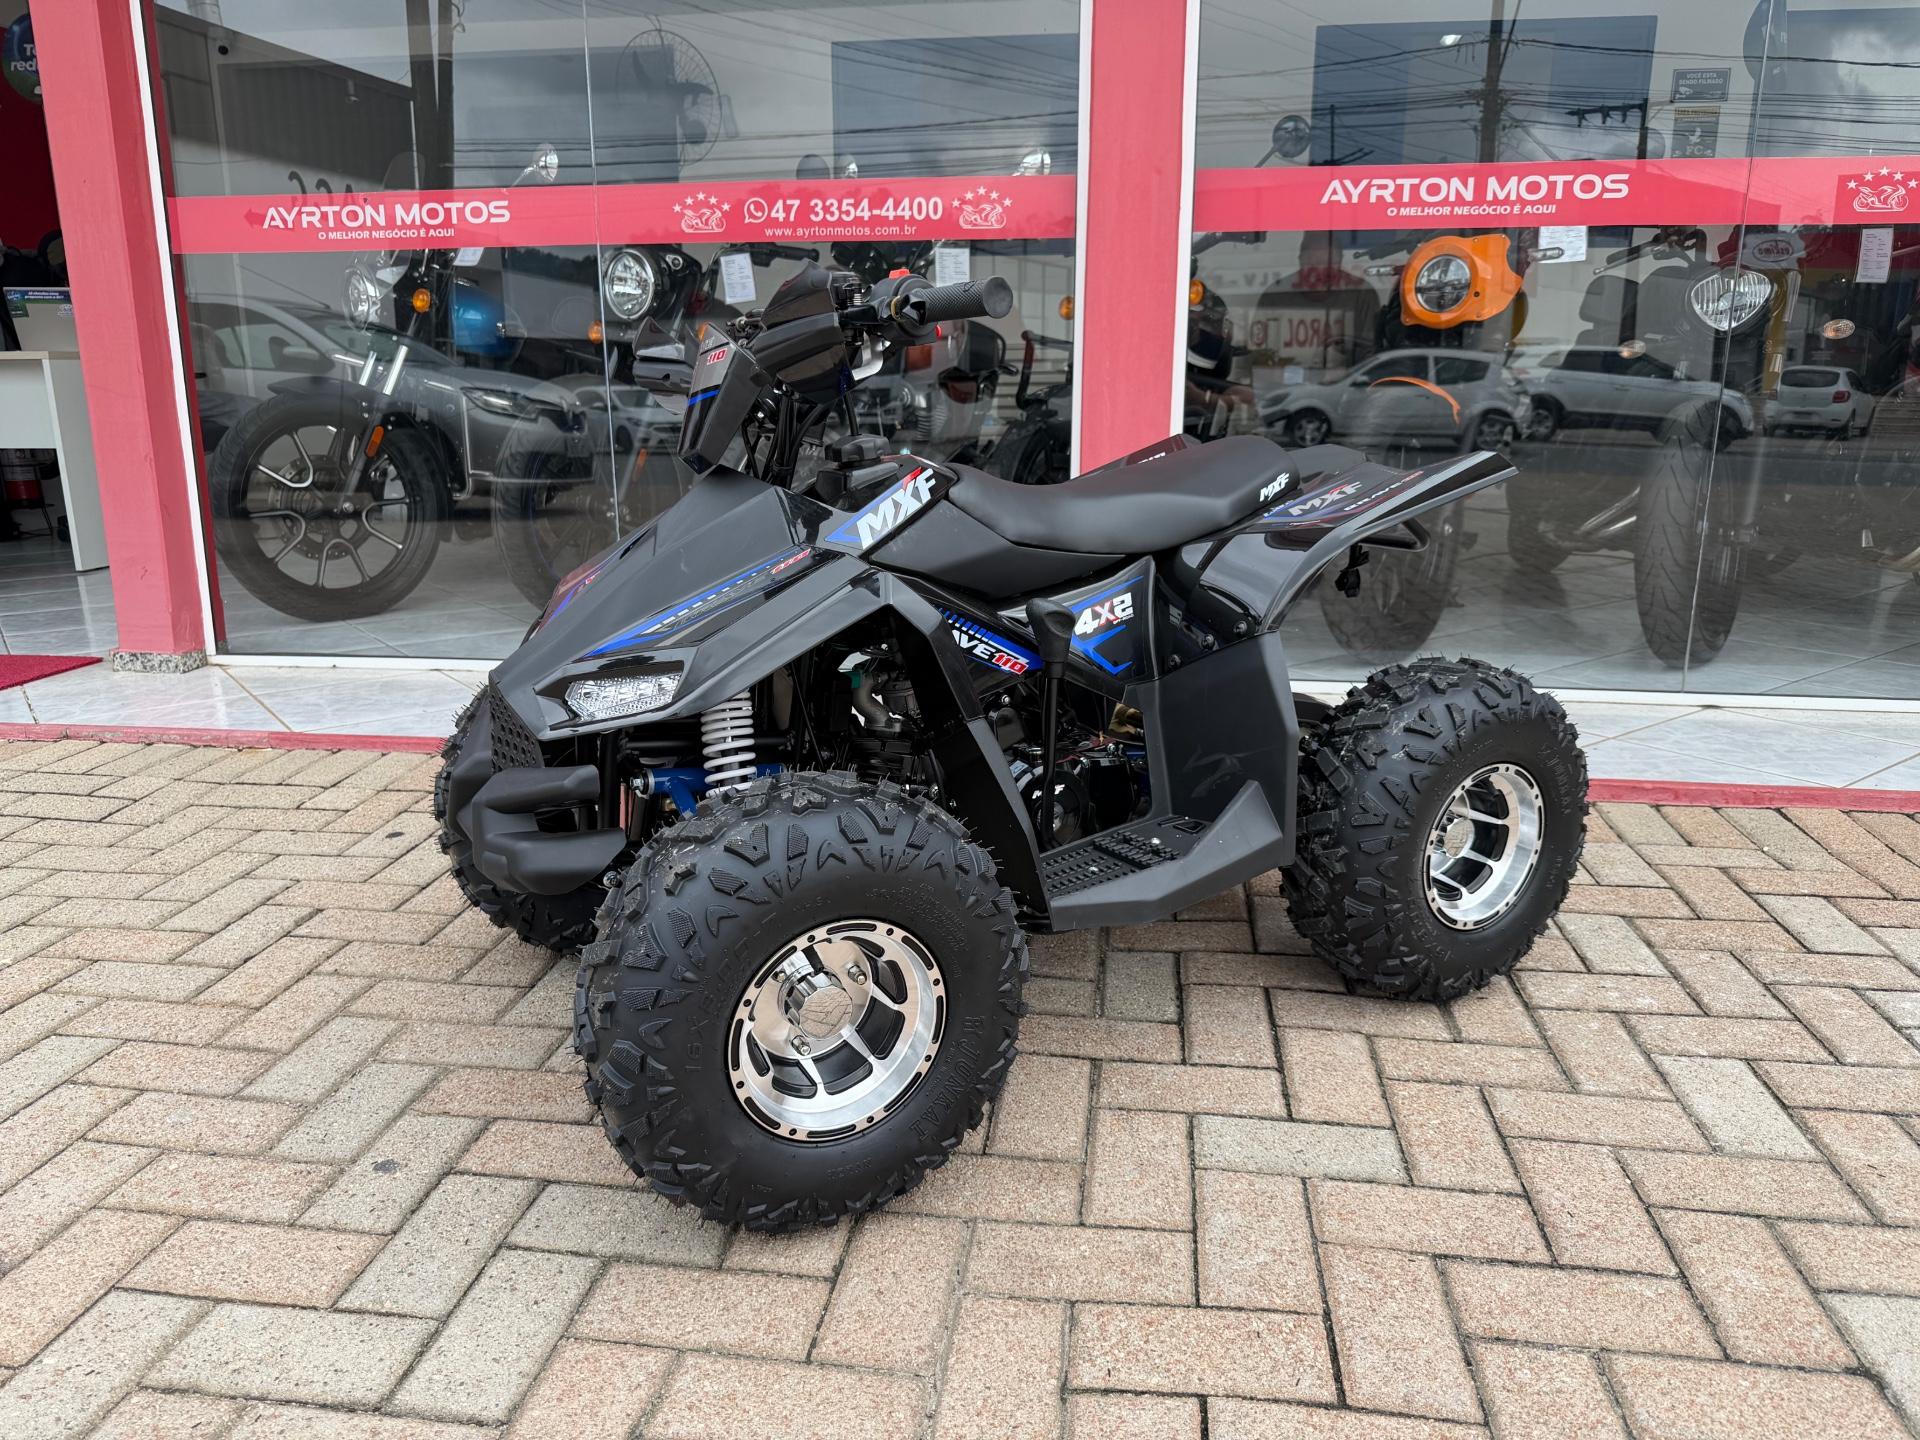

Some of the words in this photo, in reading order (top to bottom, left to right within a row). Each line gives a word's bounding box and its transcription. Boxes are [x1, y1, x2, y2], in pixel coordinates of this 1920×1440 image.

[1320, 176, 1475, 204] AYRTON
[1486, 173, 1630, 201] MOTOS
[262, 204, 386, 229] AYRTON
[394, 200, 511, 226] MOTOS
[770, 198, 801, 222] 47
[809, 196, 943, 222] 3354-4400
[1387, 206, 1397, 216] O
[1399, 206, 1451, 216] MELHOR
[1453, 204, 1511, 215] NEGÓCIO
[1513, 203, 1522, 214] É
[1523, 204, 1557, 214] AQUI
[318, 231, 327, 240] O
[328, 230, 370, 240] MELHOR
[371, 227, 418, 239] NEGÓCIO
[420, 227, 427, 238] É
[428, 228, 455, 238] AQUI
[764, 224, 917, 238] www.ayrtonmotos.com.br
[1259, 472, 1290, 502] MXF
[1287, 481, 1362, 516] MXF
[856, 467, 936, 550] MXF
